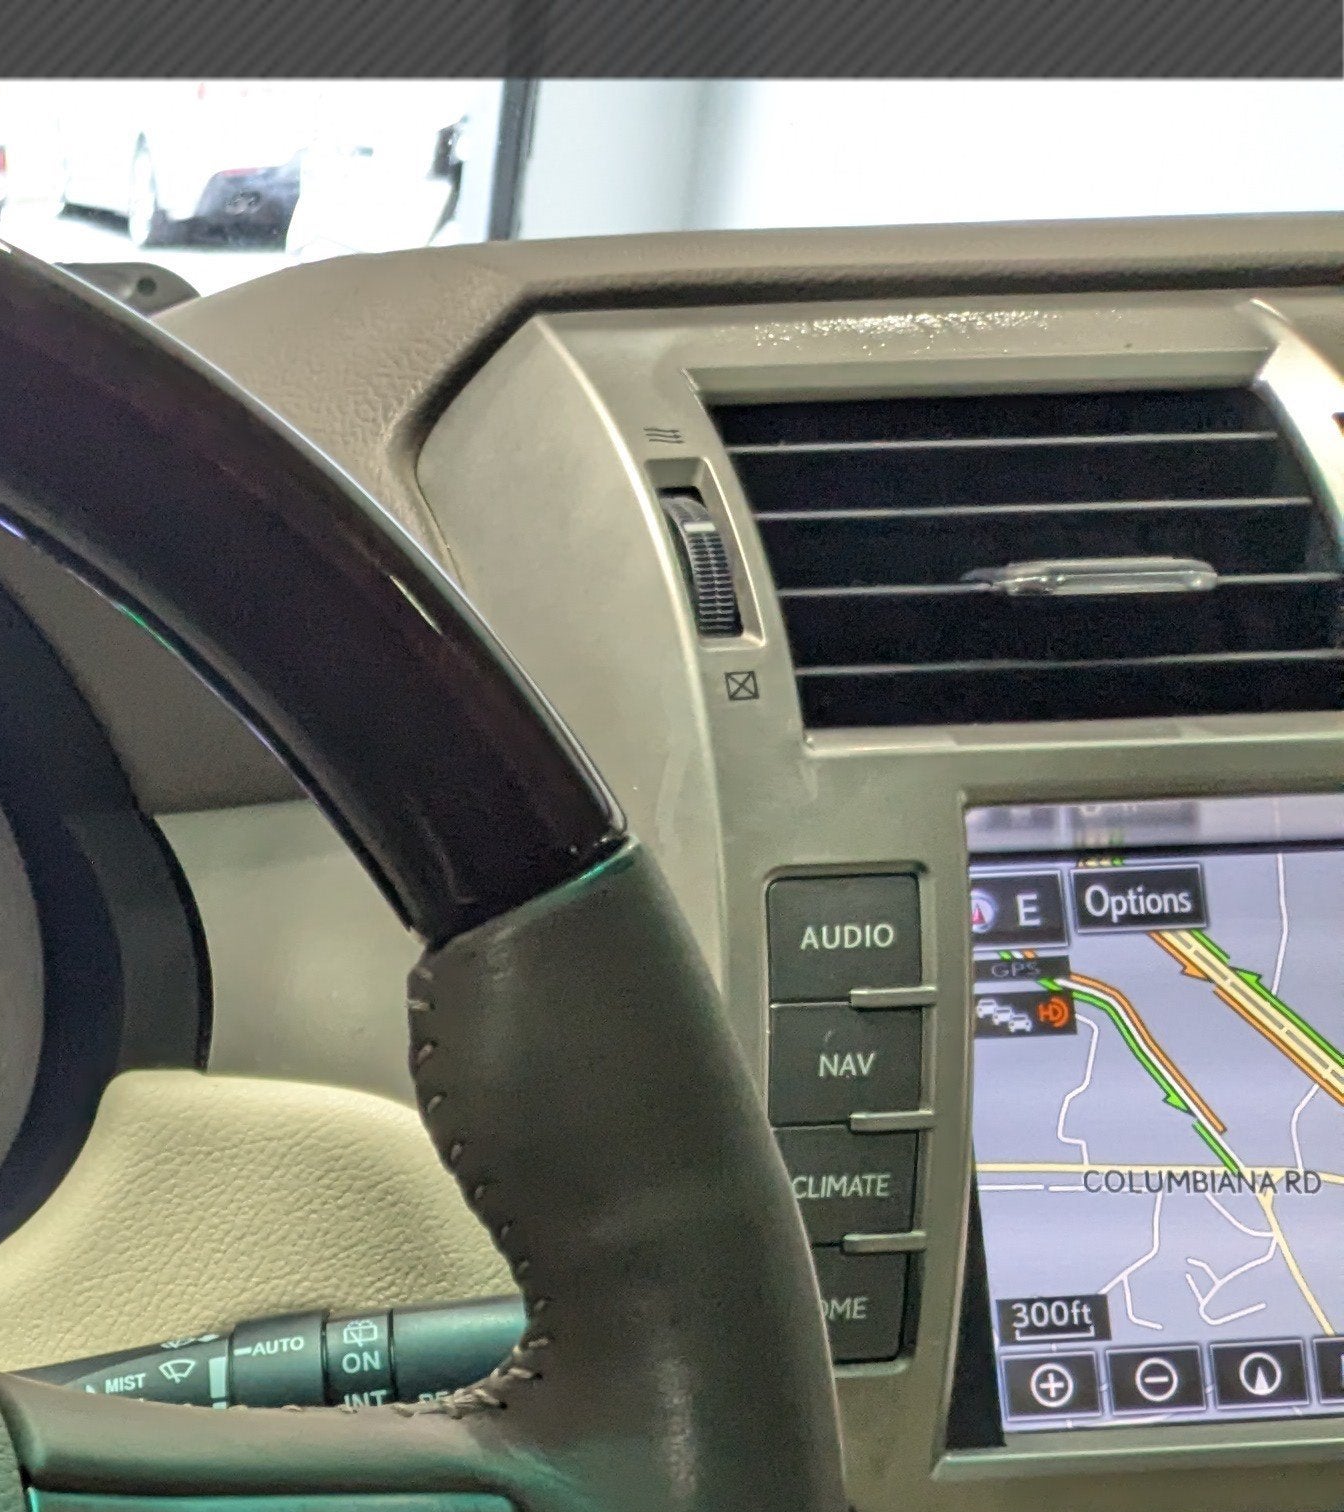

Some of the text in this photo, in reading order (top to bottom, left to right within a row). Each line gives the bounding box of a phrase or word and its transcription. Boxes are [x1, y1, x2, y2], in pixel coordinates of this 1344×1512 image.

[1016, 894, 1042, 927] E
[1084, 882, 1192, 924] Options
[801, 925, 894, 950] AUDIO
[991, 960, 1041, 979] GPS
[819, 1053, 875, 1077] NAV
[792, 1174, 889, 1199] CLIMATE
[1083, 1169, 1322, 1195] COLUMBIANA RD
[1012, 1301, 1092, 1328] 300ft
[253, 1337, 305, 1357] AUTO
[341, 1350, 383, 1374] ON
[105, 1372, 147, 1393] MIST
